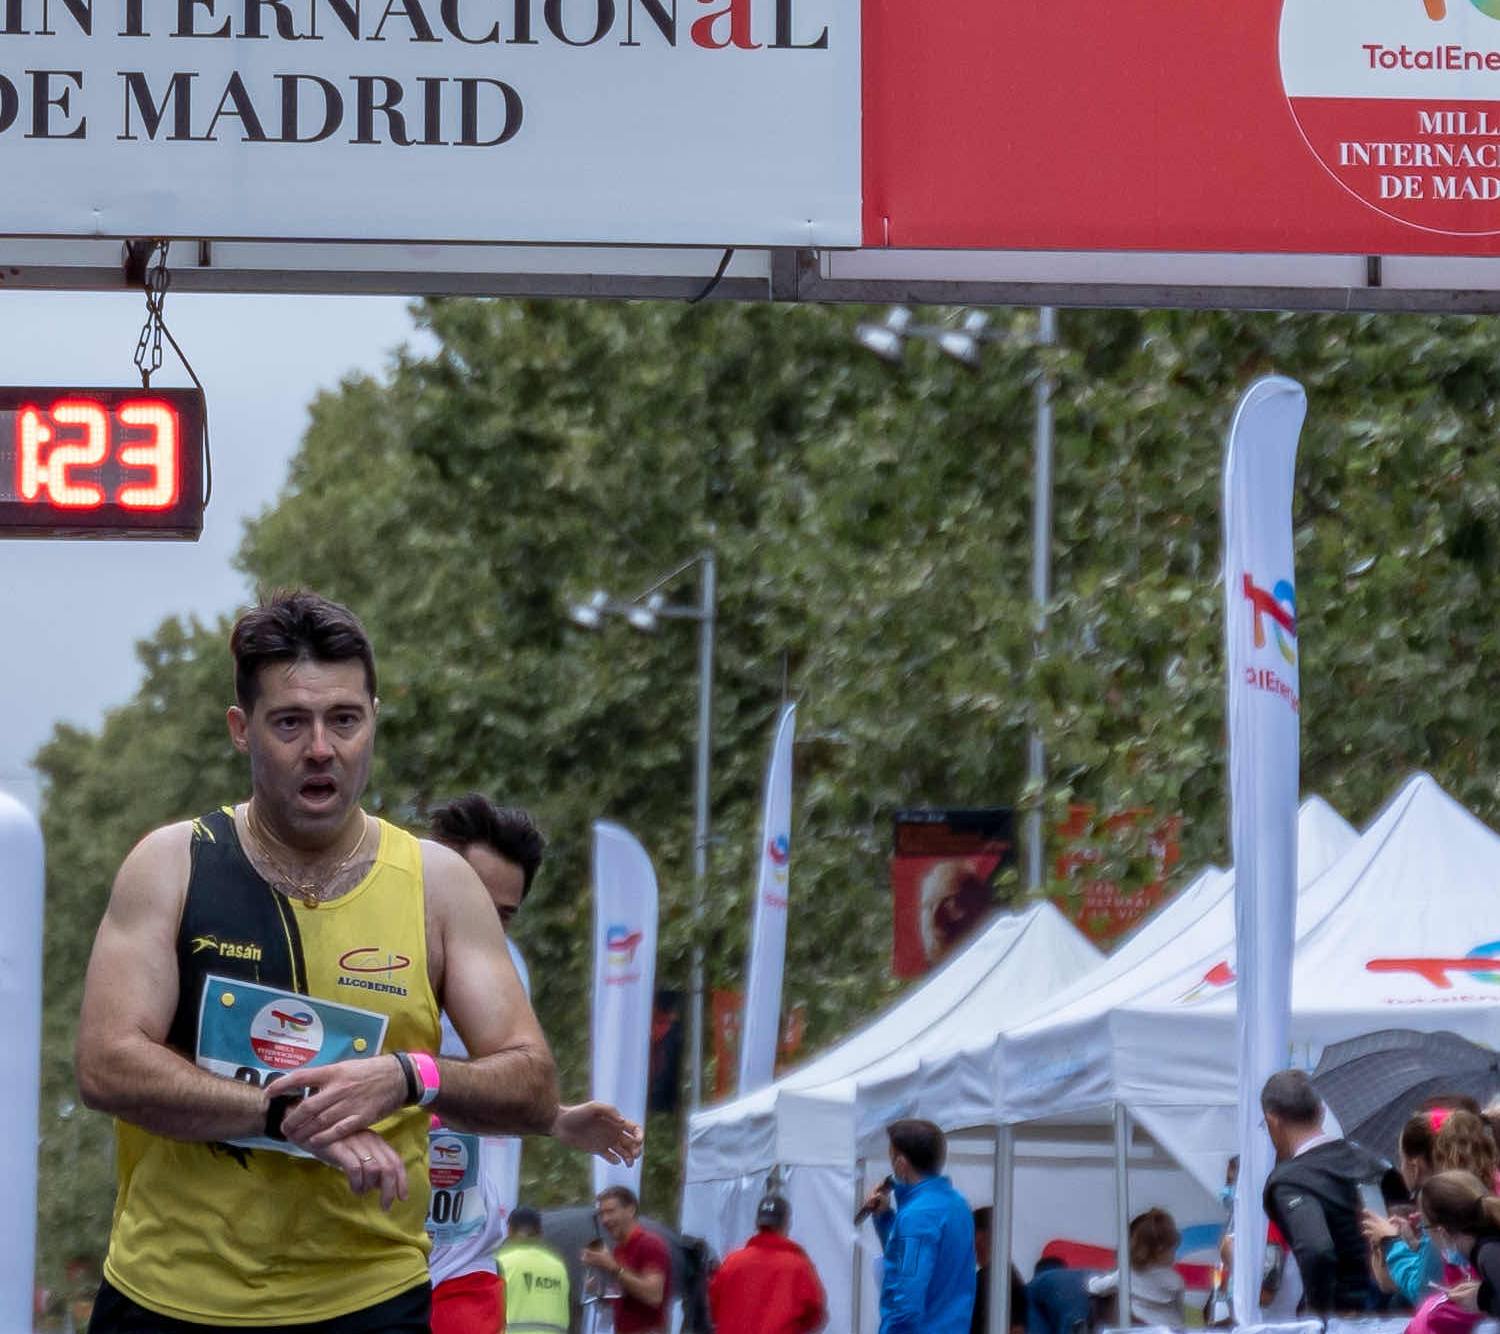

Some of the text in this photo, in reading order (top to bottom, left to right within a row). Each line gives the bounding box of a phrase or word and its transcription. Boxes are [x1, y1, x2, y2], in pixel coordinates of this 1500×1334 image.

[116, 70, 524, 148] MADRID
[1380, 175, 1423, 199] DE
[337, 976, 408, 997] ALCOBENDAS
[427, 1189, 465, 1225] 00
